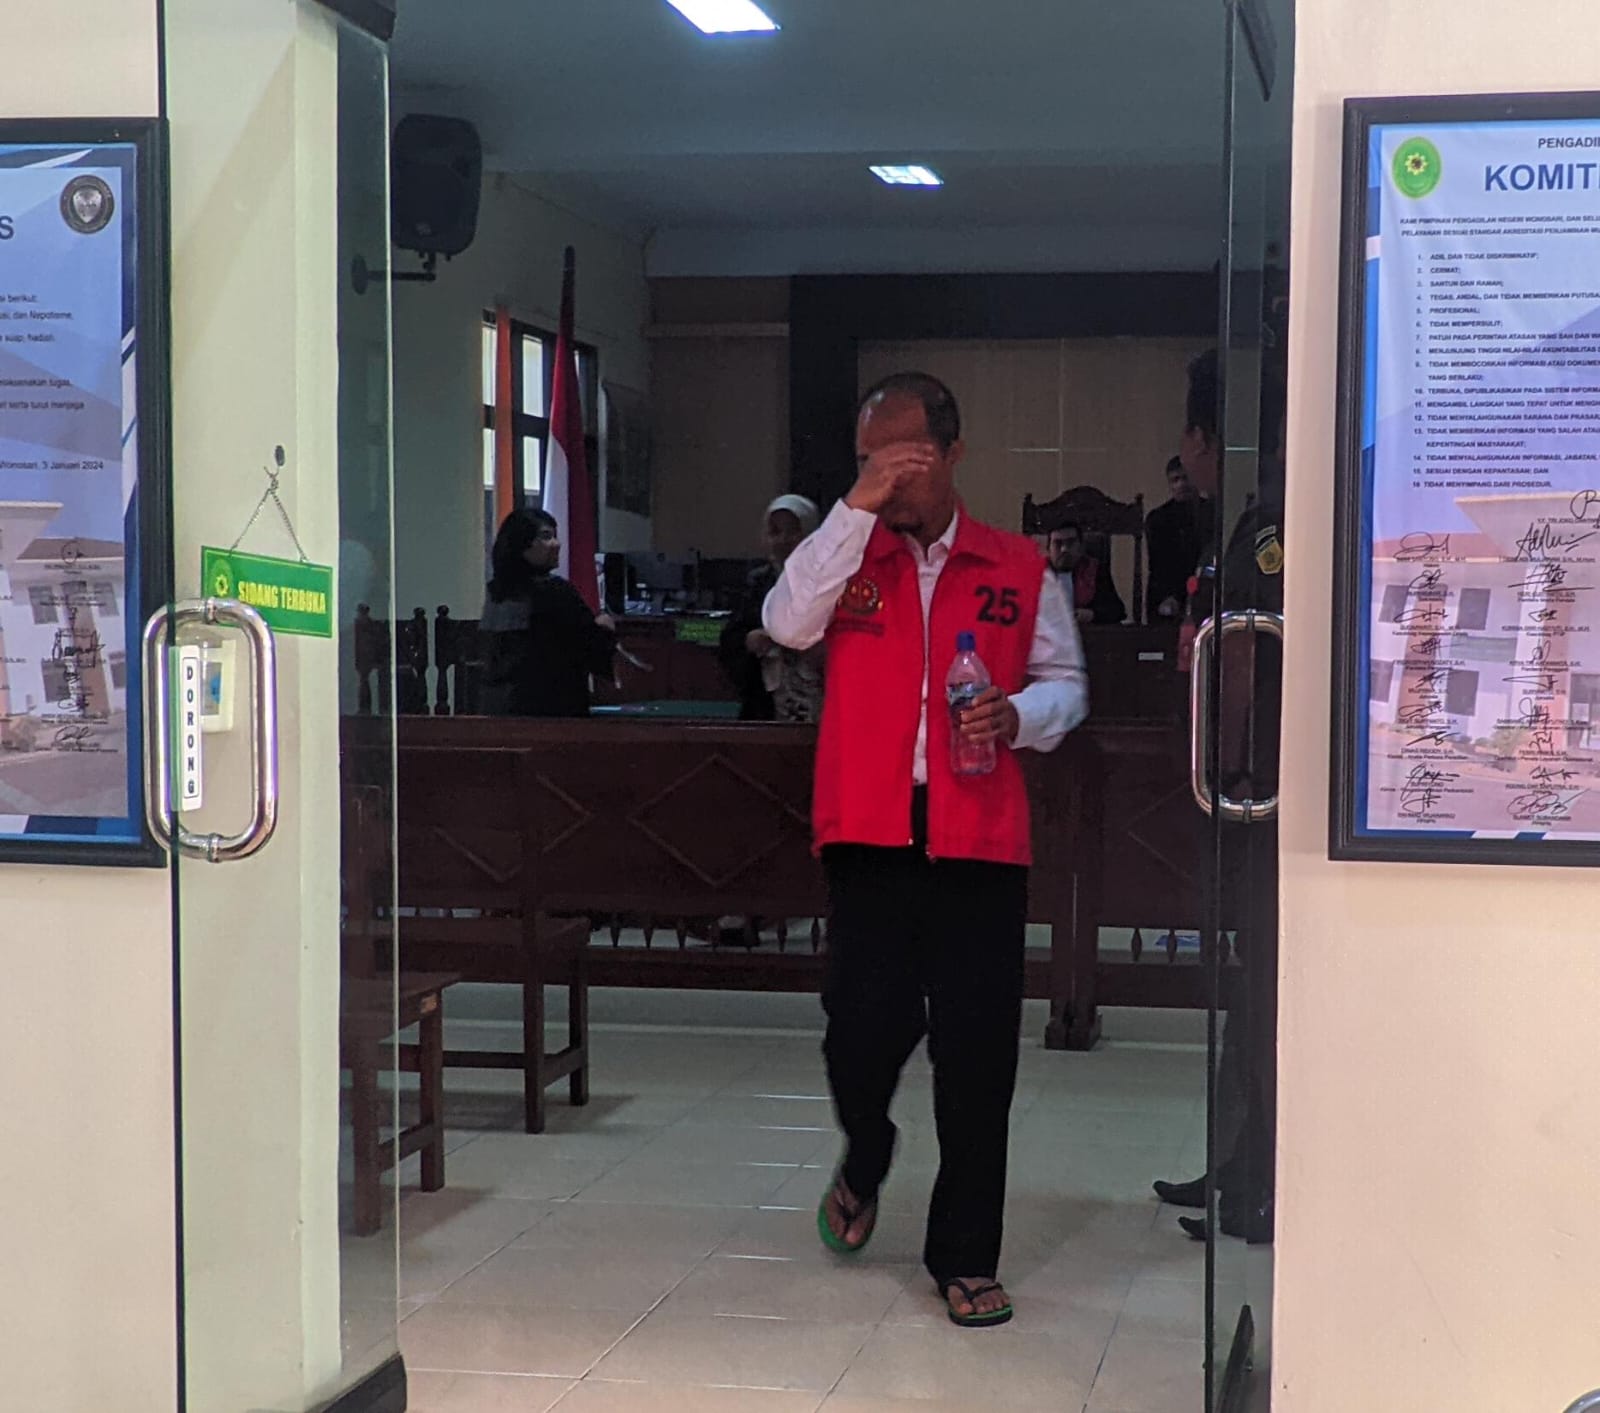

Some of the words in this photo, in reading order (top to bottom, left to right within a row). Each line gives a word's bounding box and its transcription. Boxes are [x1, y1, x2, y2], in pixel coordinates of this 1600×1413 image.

[1485, 163, 1600, 192] KOMIT
[1464, 252, 1485, 260] TIDAK
[1501, 292, 1521, 300] TIDAK
[1429, 360, 1449, 368] TIDAK
[82, 461, 104, 470] 2024
[975, 585, 1020, 627] 25
[186, 666, 195, 794] DORONG
